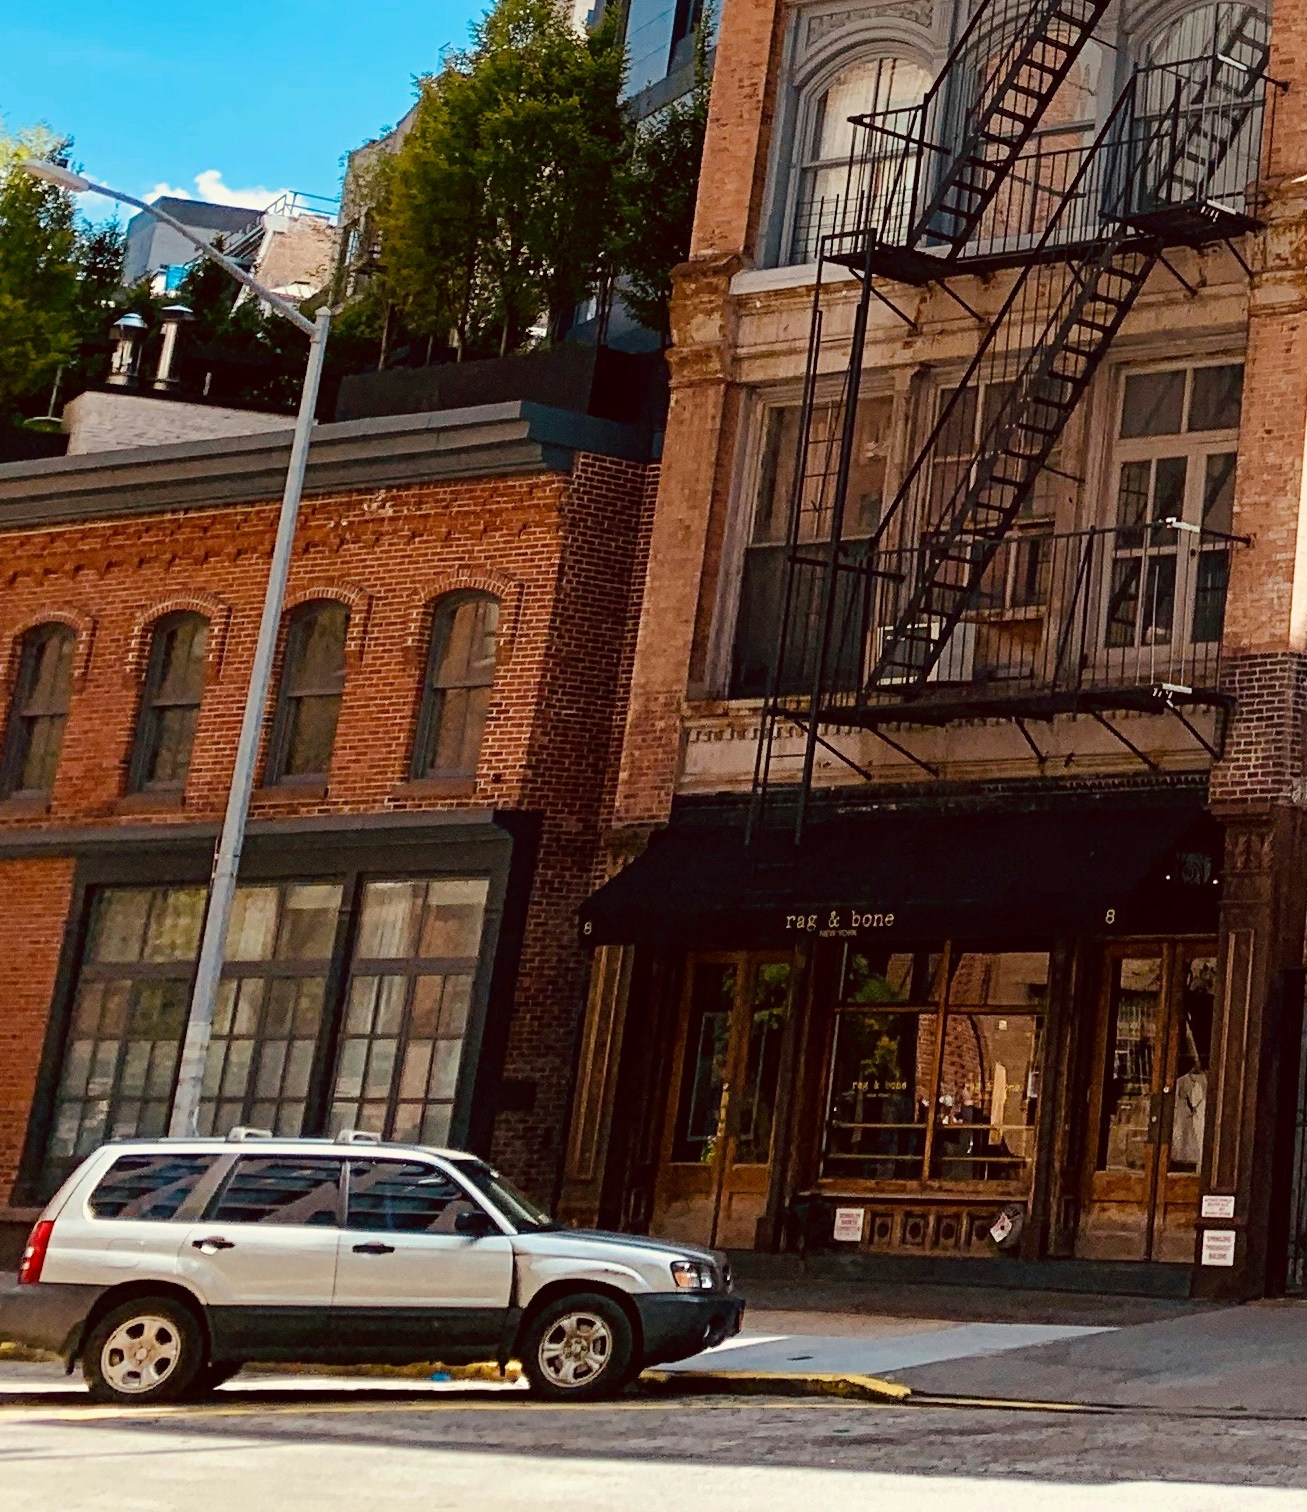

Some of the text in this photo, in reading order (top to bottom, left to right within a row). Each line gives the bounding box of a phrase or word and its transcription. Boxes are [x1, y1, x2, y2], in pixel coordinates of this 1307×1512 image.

[785, 910, 895, 932] rag & bone
[1105, 909, 1116, 925] 8
